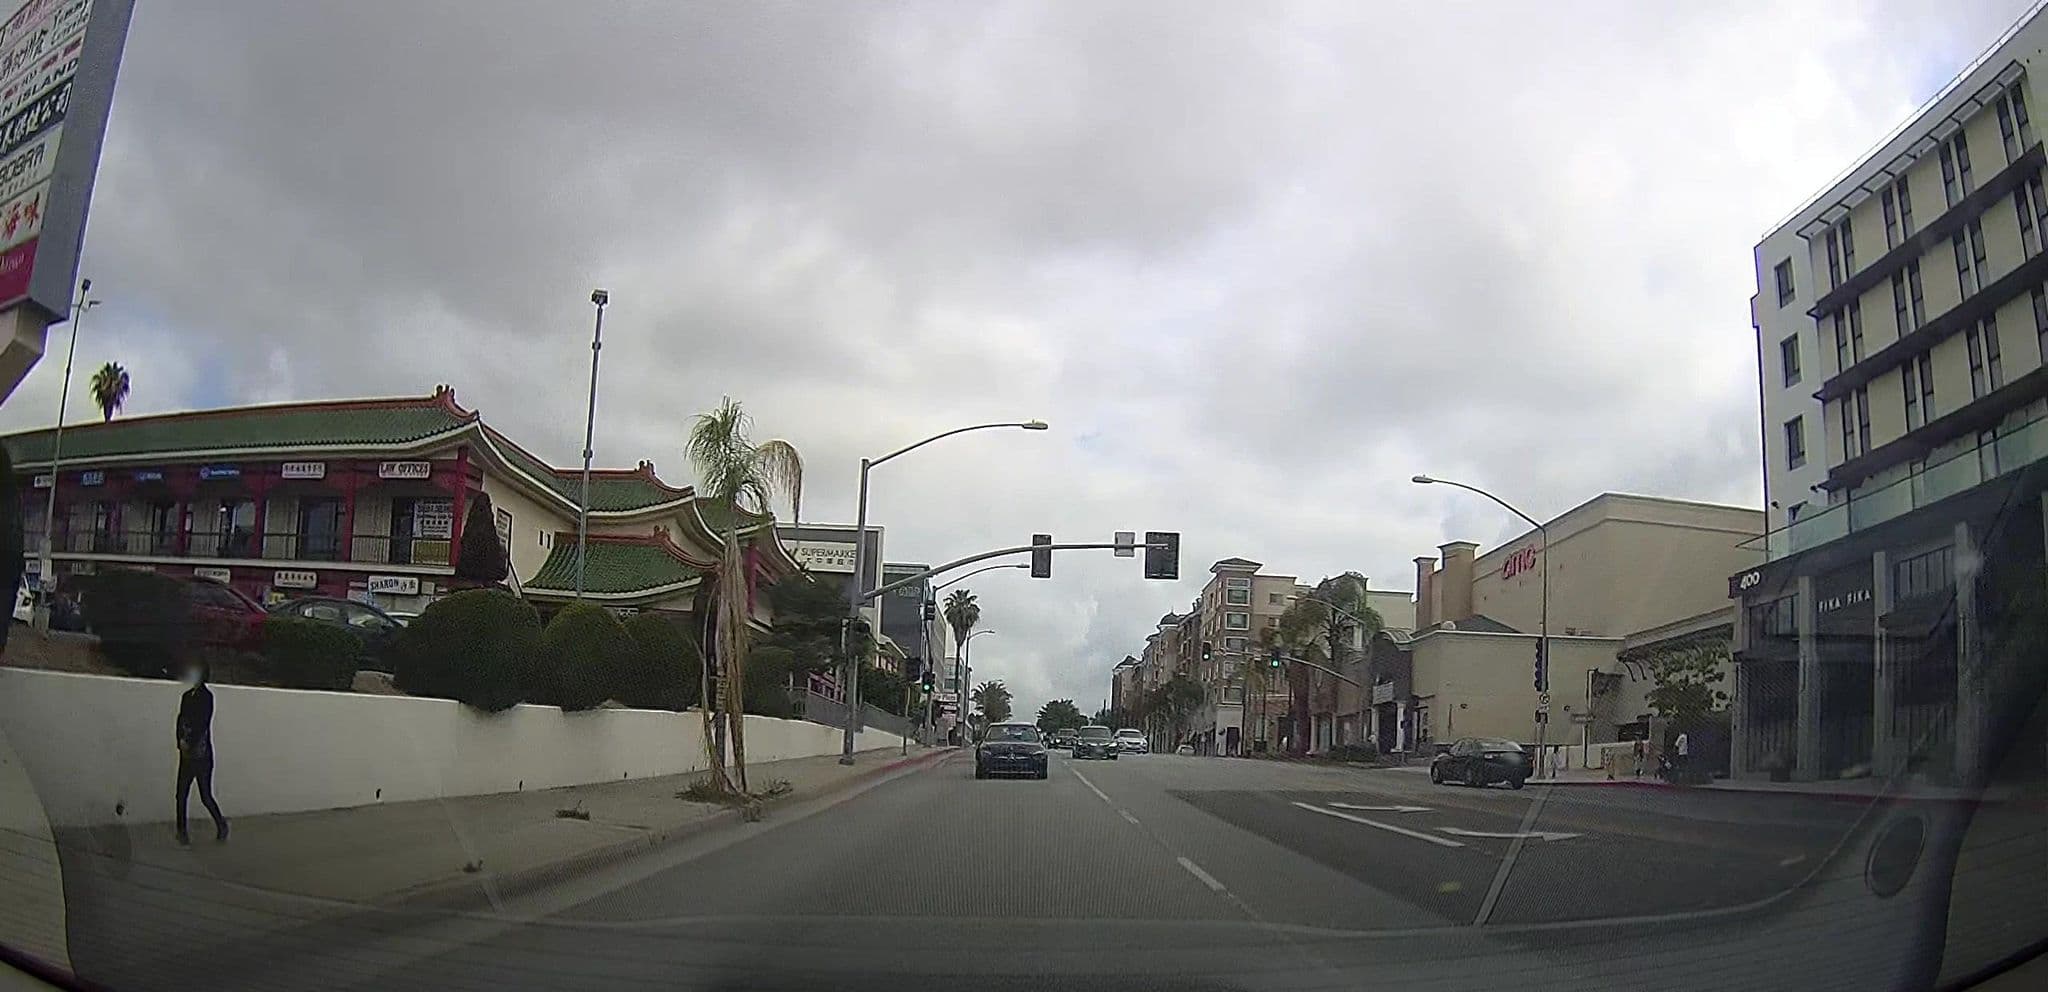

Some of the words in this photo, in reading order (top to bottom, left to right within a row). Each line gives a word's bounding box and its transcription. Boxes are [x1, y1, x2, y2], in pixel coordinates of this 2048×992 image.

[16, 58, 79, 107] ISLAND
[398, 463, 429, 474] OFFICES
[801, 547, 857, 558] SUPERMARKE
[1740, 571, 1760, 590] 400
[1818, 596, 1841, 613] FIKA
[1847, 589, 1872, 607] FIKA
